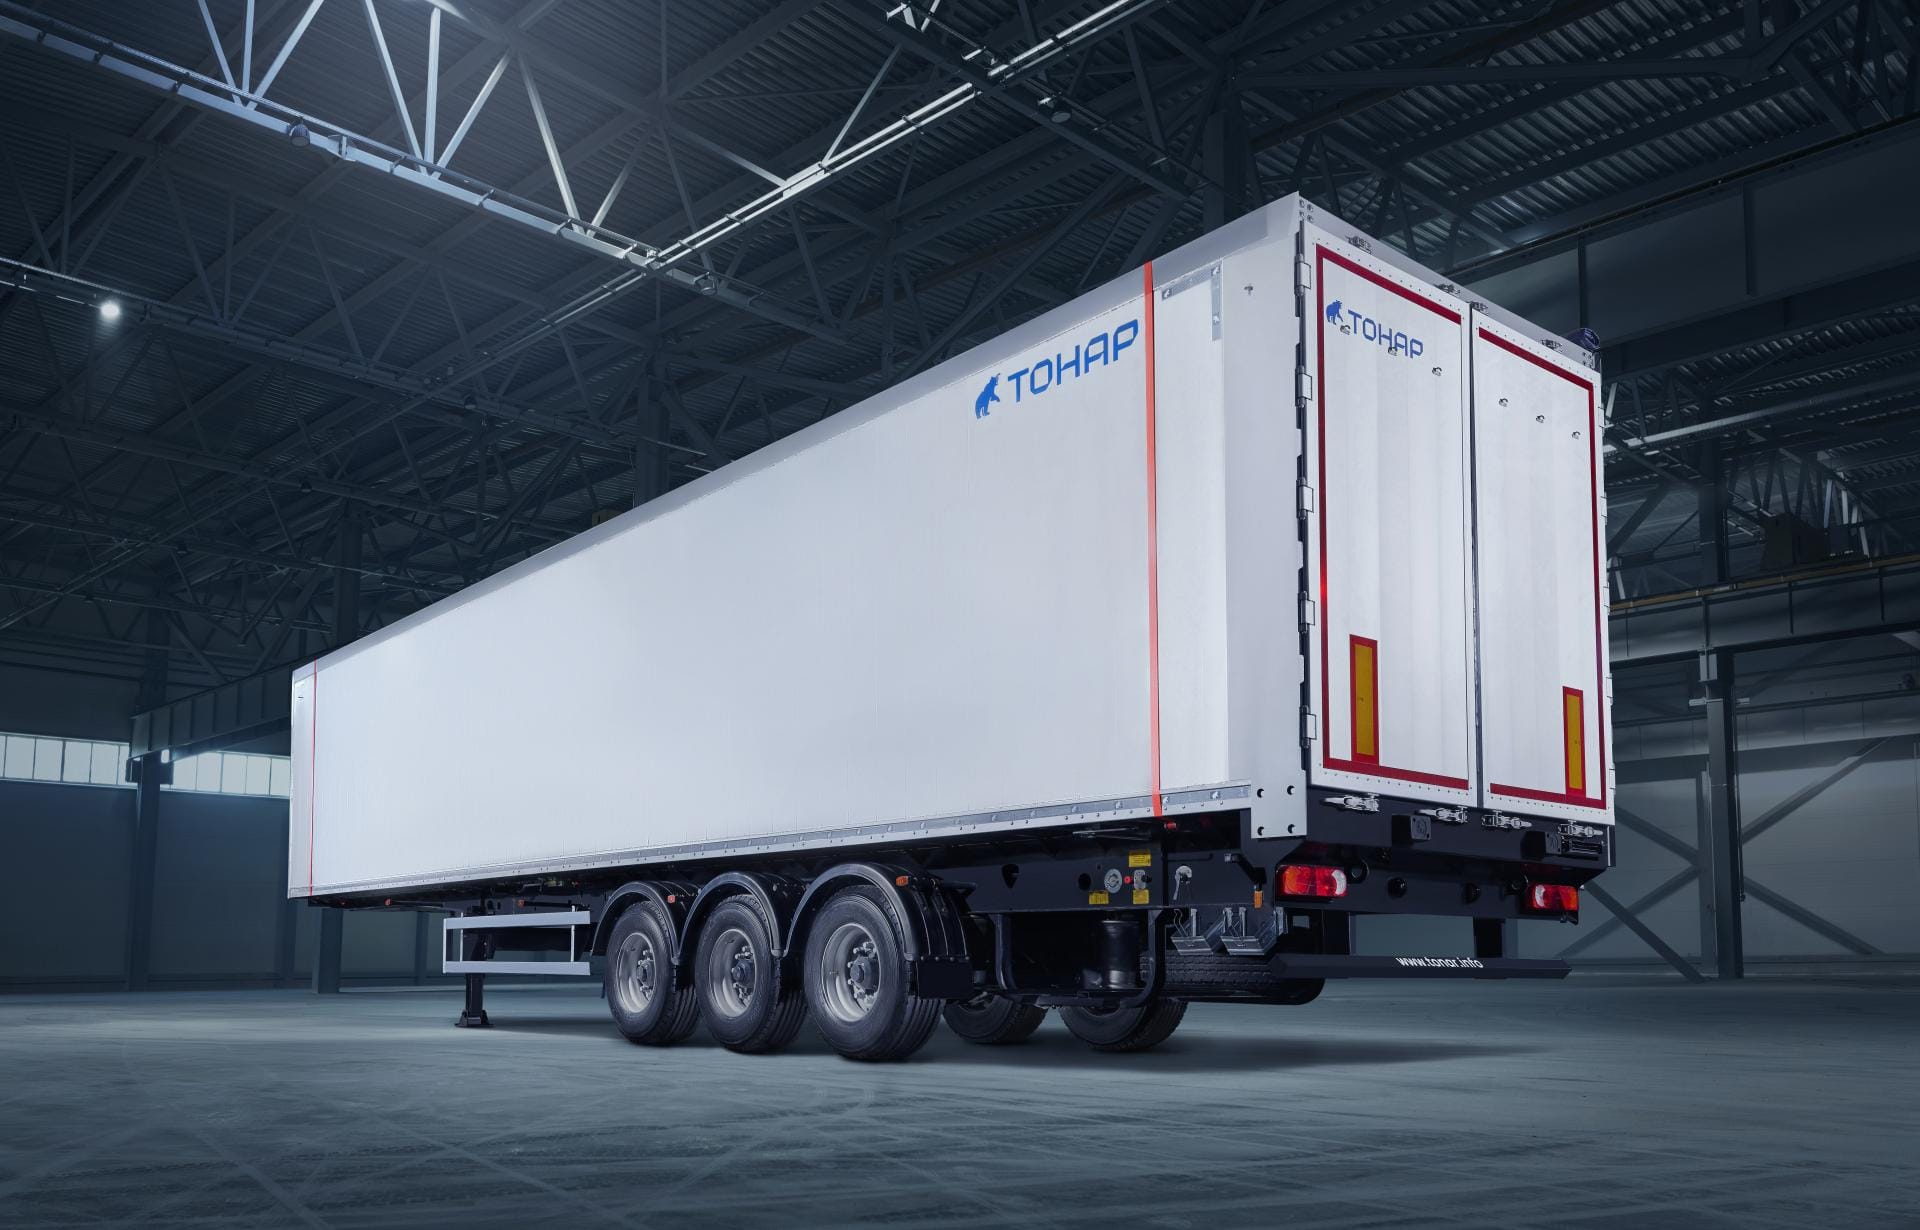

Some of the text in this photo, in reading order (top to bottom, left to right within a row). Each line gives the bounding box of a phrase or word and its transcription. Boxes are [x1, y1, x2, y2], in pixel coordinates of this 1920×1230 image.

[1347, 309, 1424, 359] ТОНАР
[1007, 318, 1139, 403] ТОНАР
[1395, 956, 1484, 969] www.tonar.info
